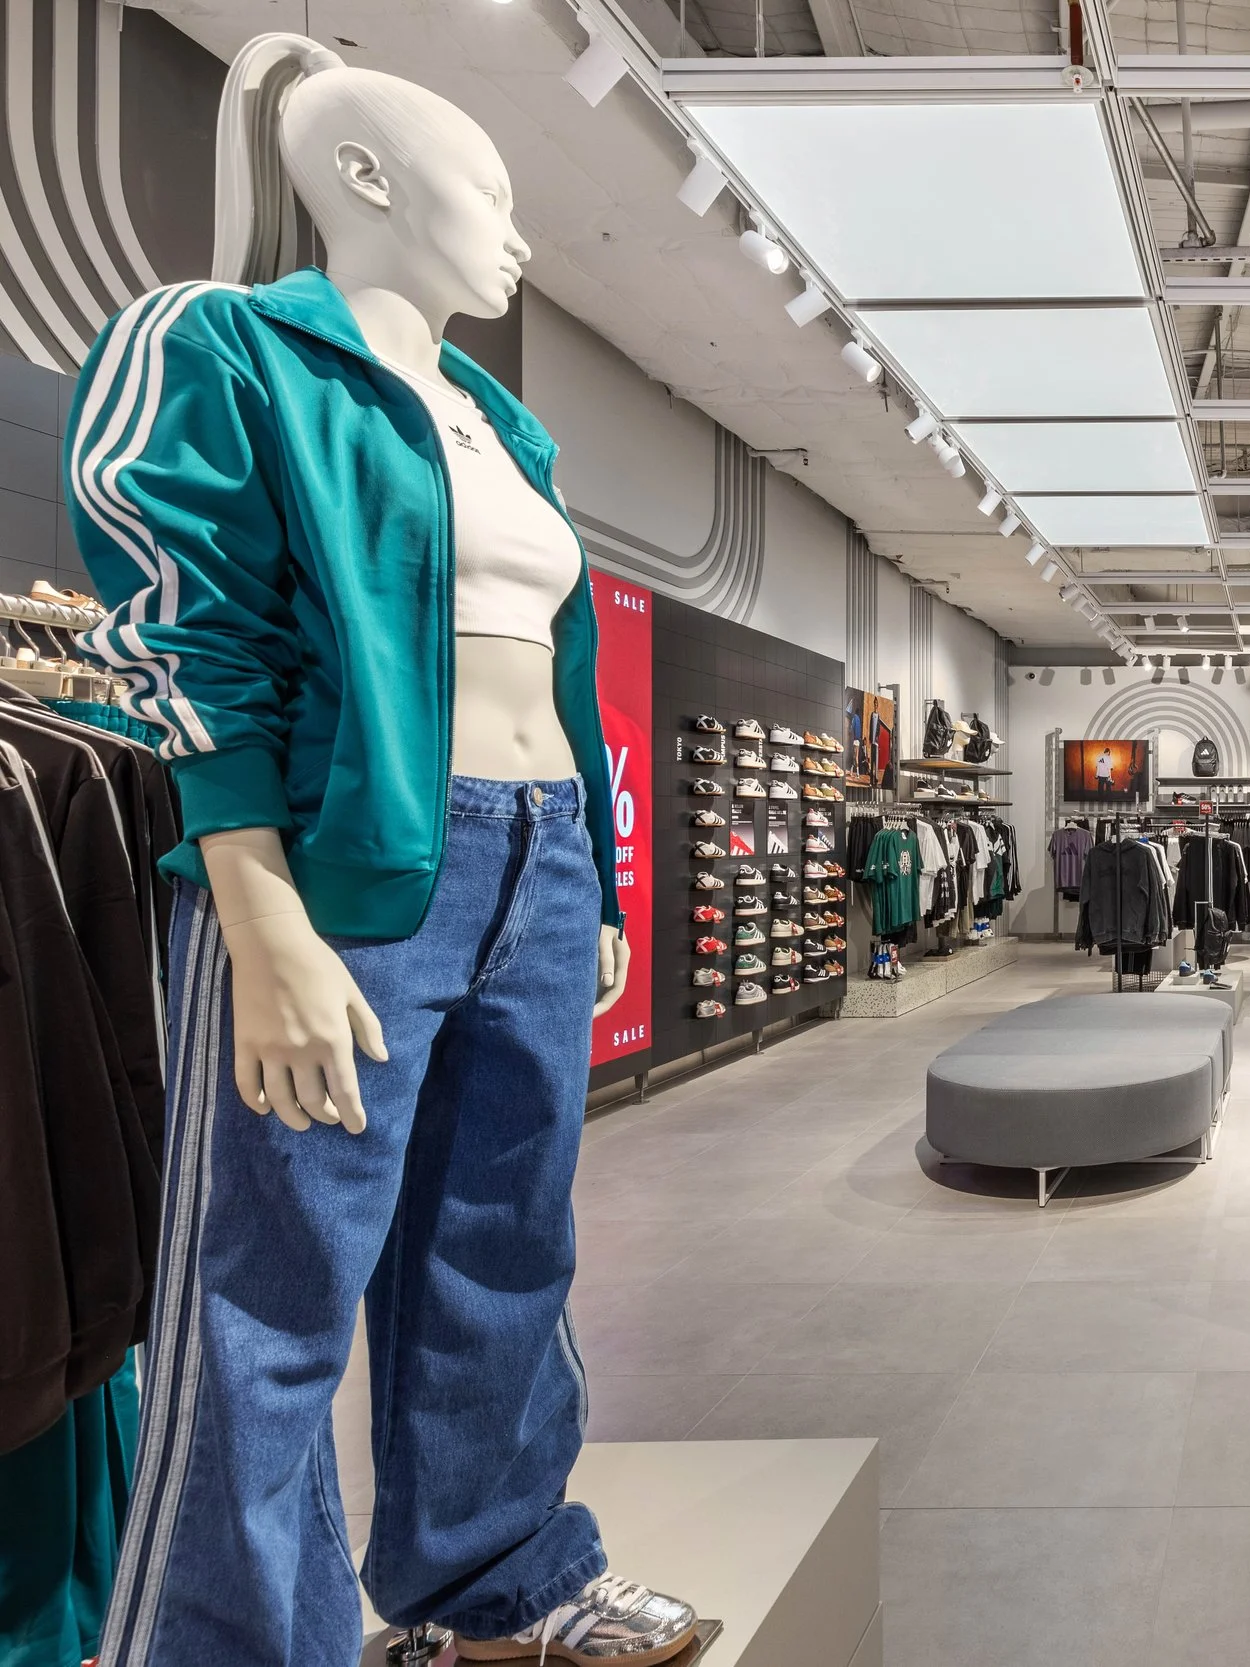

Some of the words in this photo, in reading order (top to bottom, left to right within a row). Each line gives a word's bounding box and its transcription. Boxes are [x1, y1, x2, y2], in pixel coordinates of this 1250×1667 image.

[614, 590, 645, 613] SALE
[616, 846, 635, 864] OFF
[613, 1024, 645, 1047] SALE
